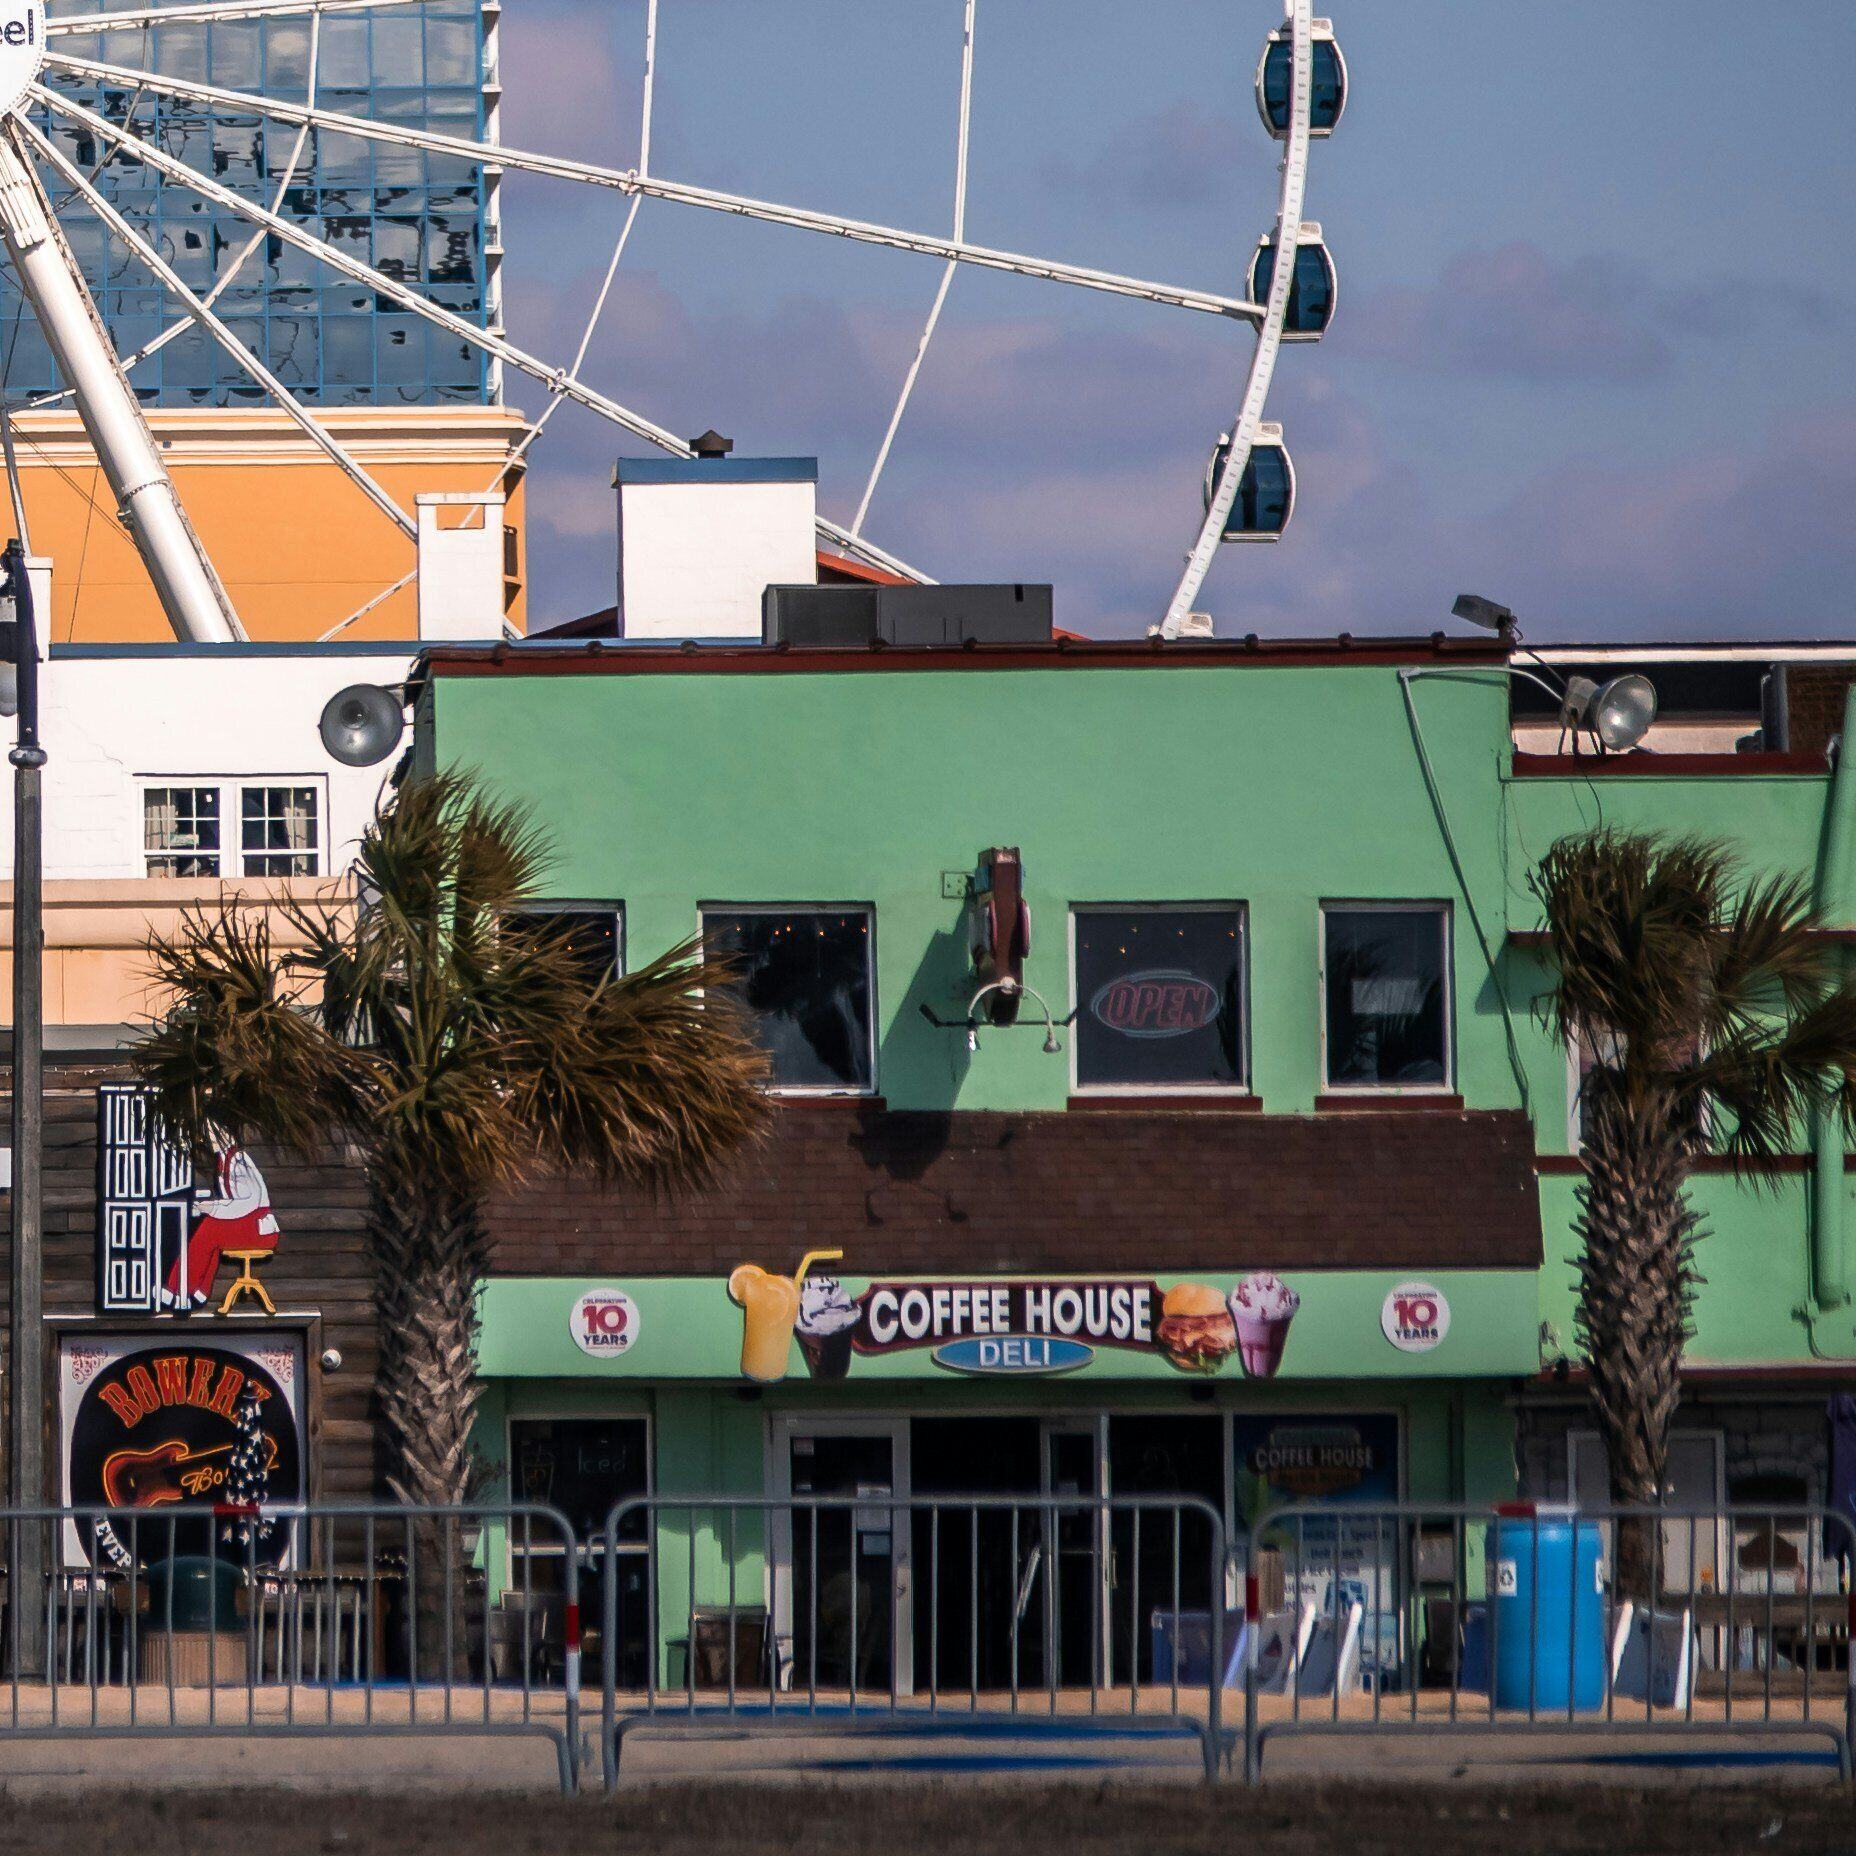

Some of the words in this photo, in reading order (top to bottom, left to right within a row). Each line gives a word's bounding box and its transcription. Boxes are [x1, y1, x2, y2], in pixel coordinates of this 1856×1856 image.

[1108, 983, 1209, 1028] OPEN
[583, 1305, 628, 1334] 10
[869, 1289, 1010, 1343] COFFEE
[1026, 1287, 1152, 1342] HOUSE
[1394, 1300, 1438, 1328] 10
[583, 1334, 628, 1345] YEARS
[979, 1340, 1050, 1367] DELI
[1255, 1447, 1314, 1470] COFFEE
[1321, 1446, 1373, 1470] HOUSE
